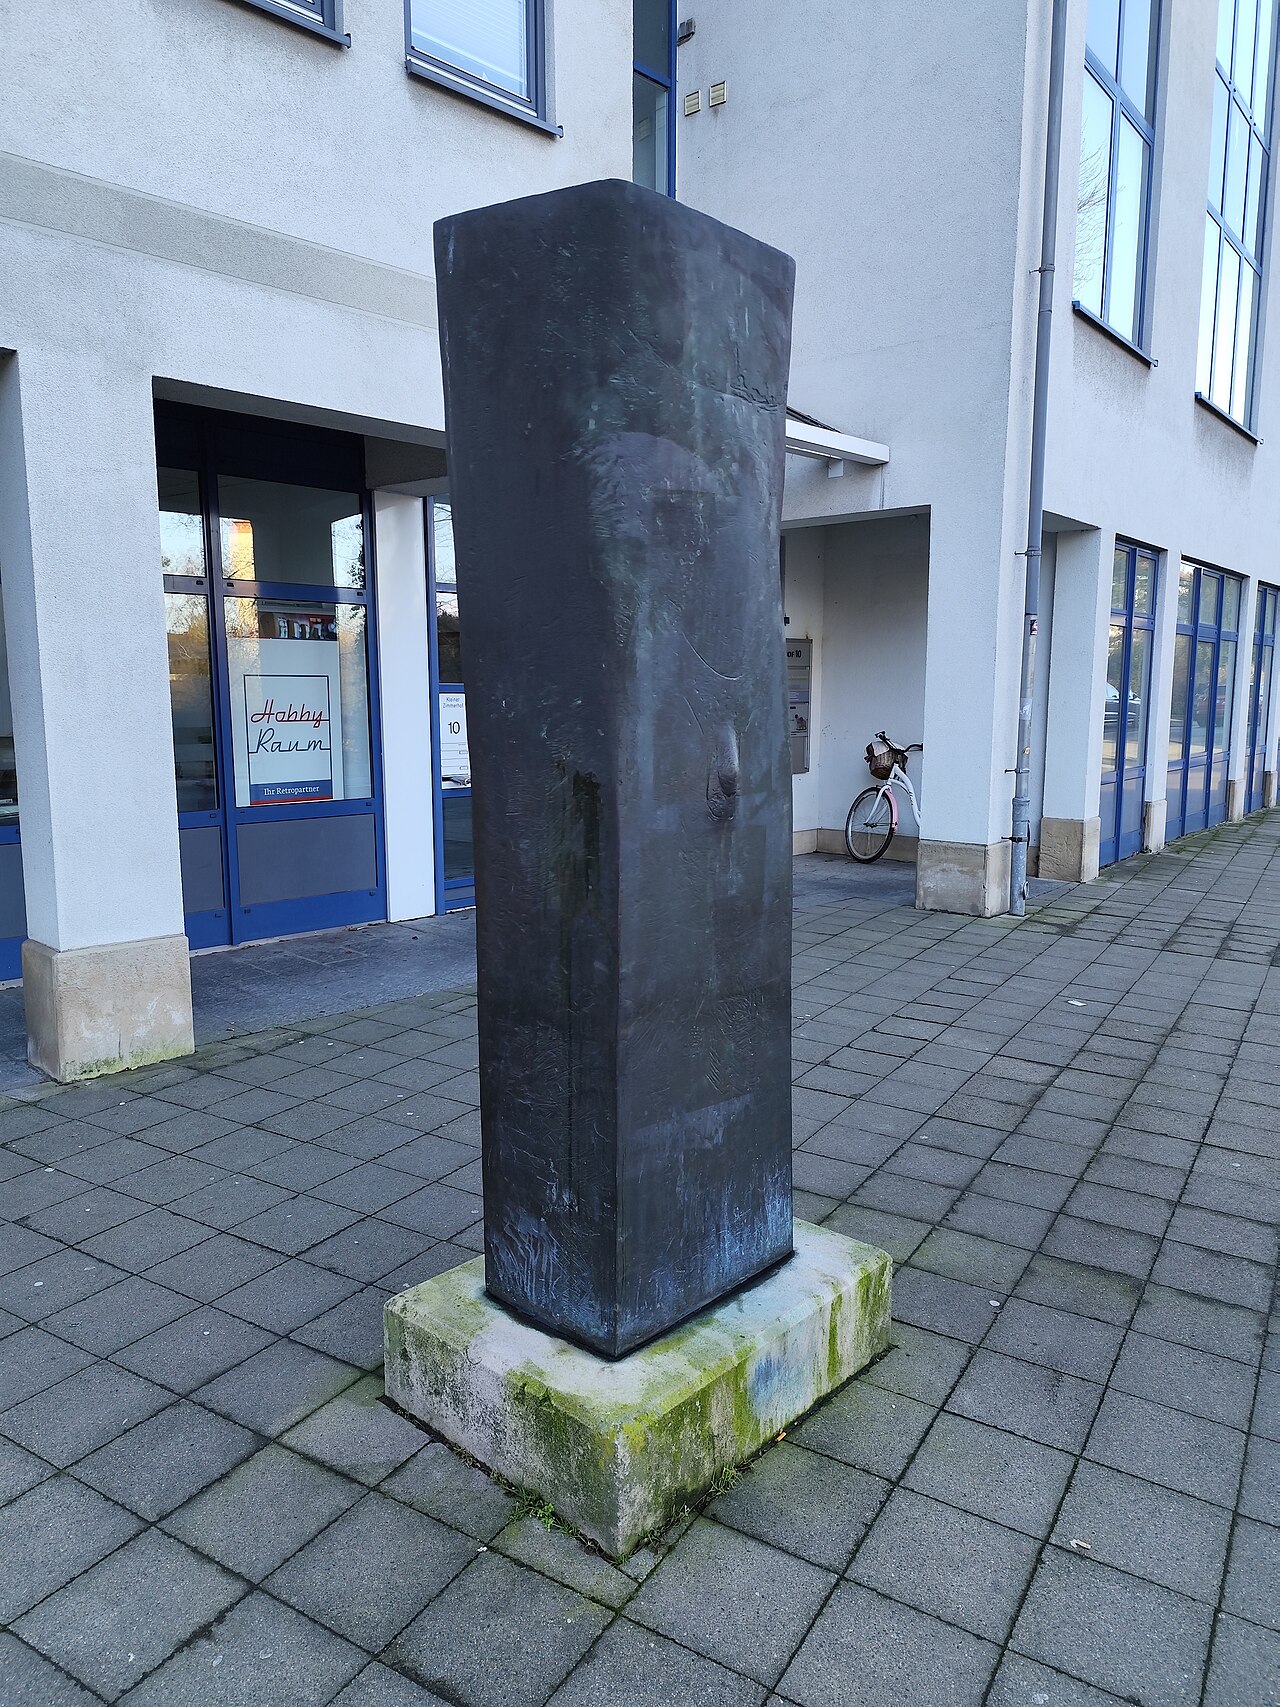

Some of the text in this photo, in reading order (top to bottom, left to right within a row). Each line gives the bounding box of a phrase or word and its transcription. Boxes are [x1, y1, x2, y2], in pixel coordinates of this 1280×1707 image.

[795, 649, 802, 658] 10
[250, 699, 323, 728] Hobby
[448, 721, 461, 734] 10
[255, 727, 324, 753] Raum
[264, 786, 320, 796] Ihr Retropartner
